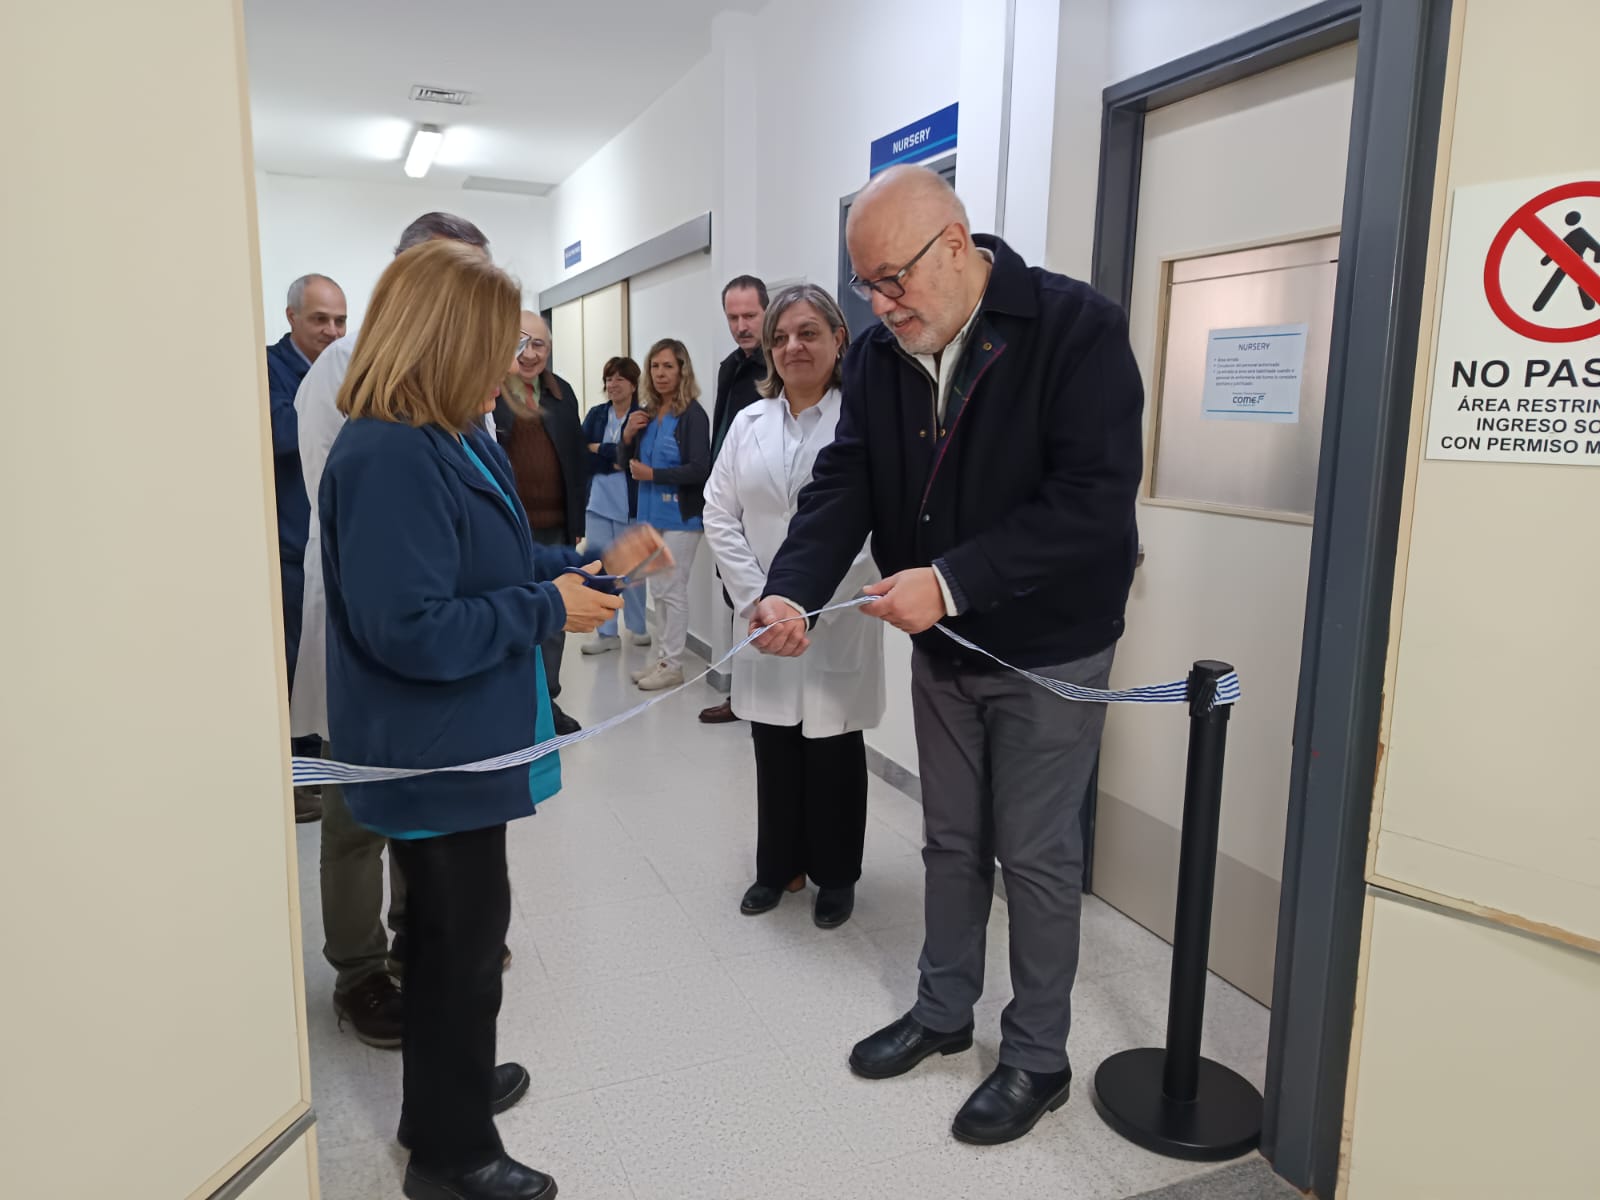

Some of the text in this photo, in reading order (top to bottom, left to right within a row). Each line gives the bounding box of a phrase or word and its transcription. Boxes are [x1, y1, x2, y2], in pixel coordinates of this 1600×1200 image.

[892, 126, 931, 155] NURSERY
[1238, 342, 1271, 351] NURSERY
[1451, 358, 1600, 388] NO PAS
[1457, 394, 1511, 412] ÁREA
[1476, 417, 1600, 434] INGRESO SO
[1441, 436, 1481, 450] CON
[1487, 437, 1579, 453] PERMISO
